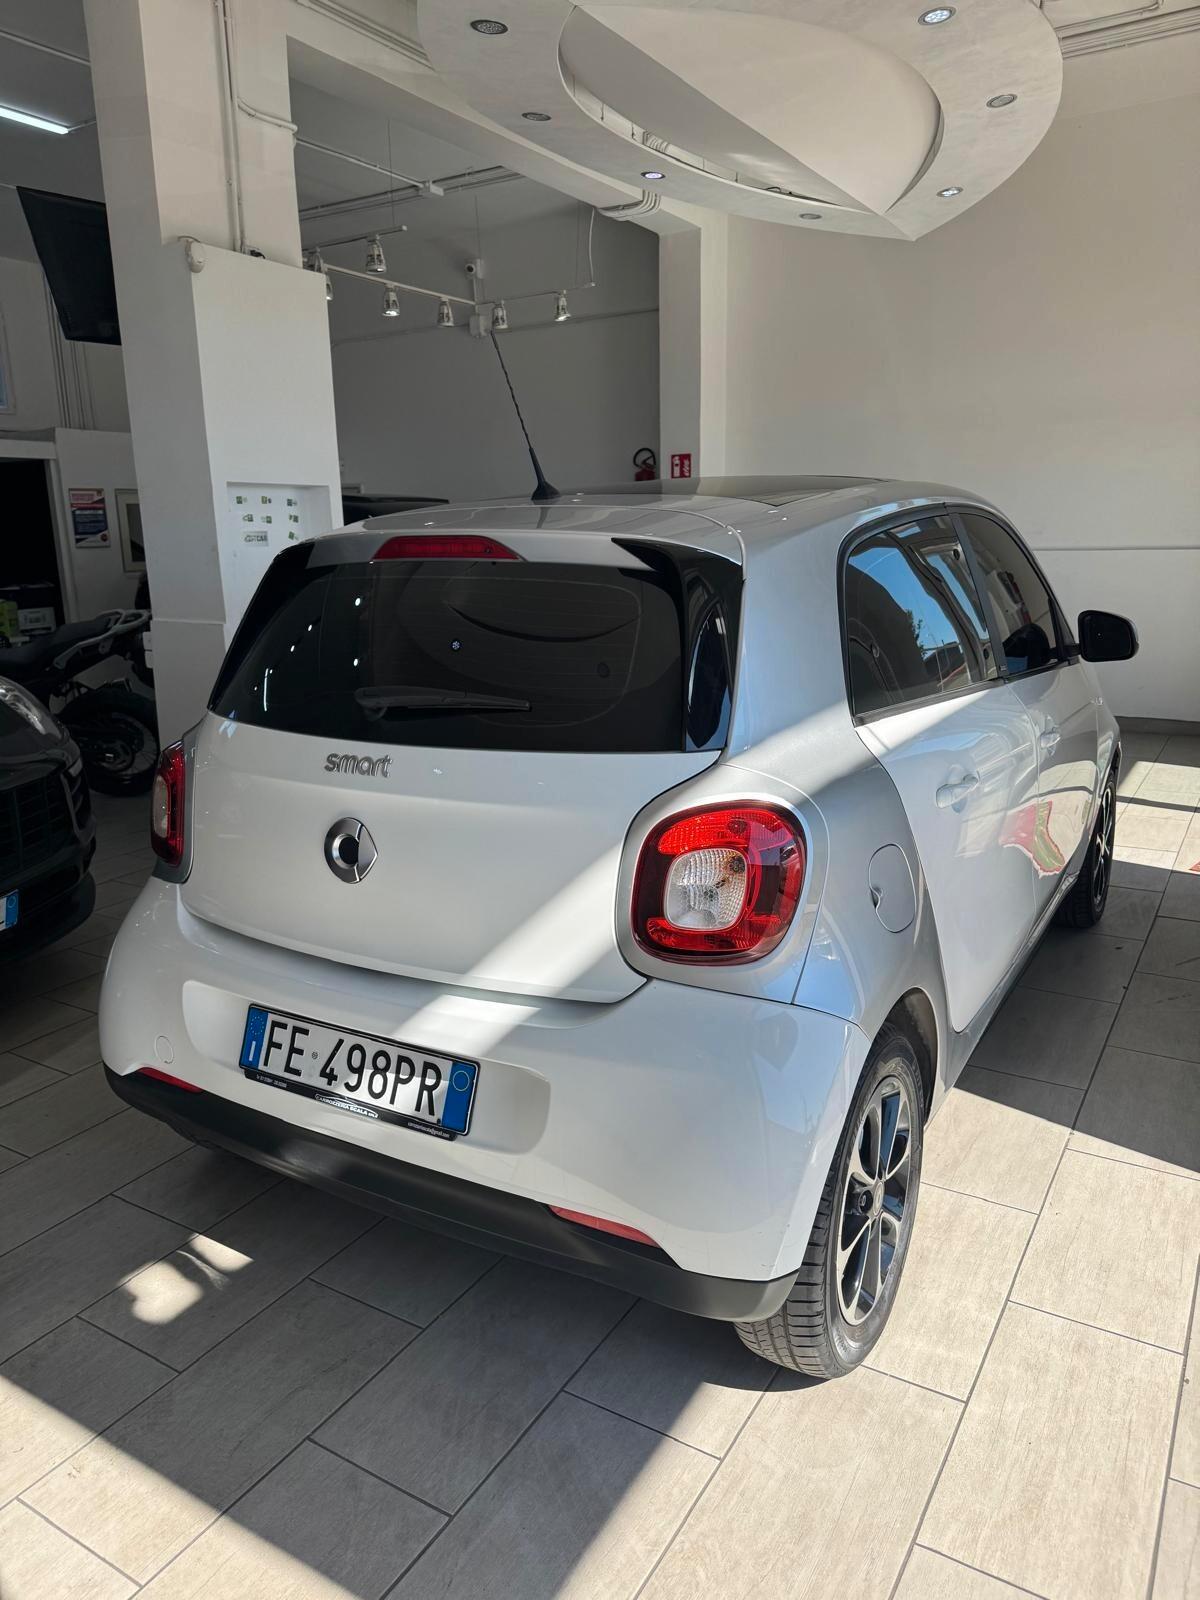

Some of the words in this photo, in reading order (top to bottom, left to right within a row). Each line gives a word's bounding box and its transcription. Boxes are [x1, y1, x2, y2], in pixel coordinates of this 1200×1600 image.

[324, 752, 393, 778] smart
[263, 1019, 310, 1077] FE
[319, 1038, 442, 1117] 498PR
[350, 1105, 368, 1116] SCALA
